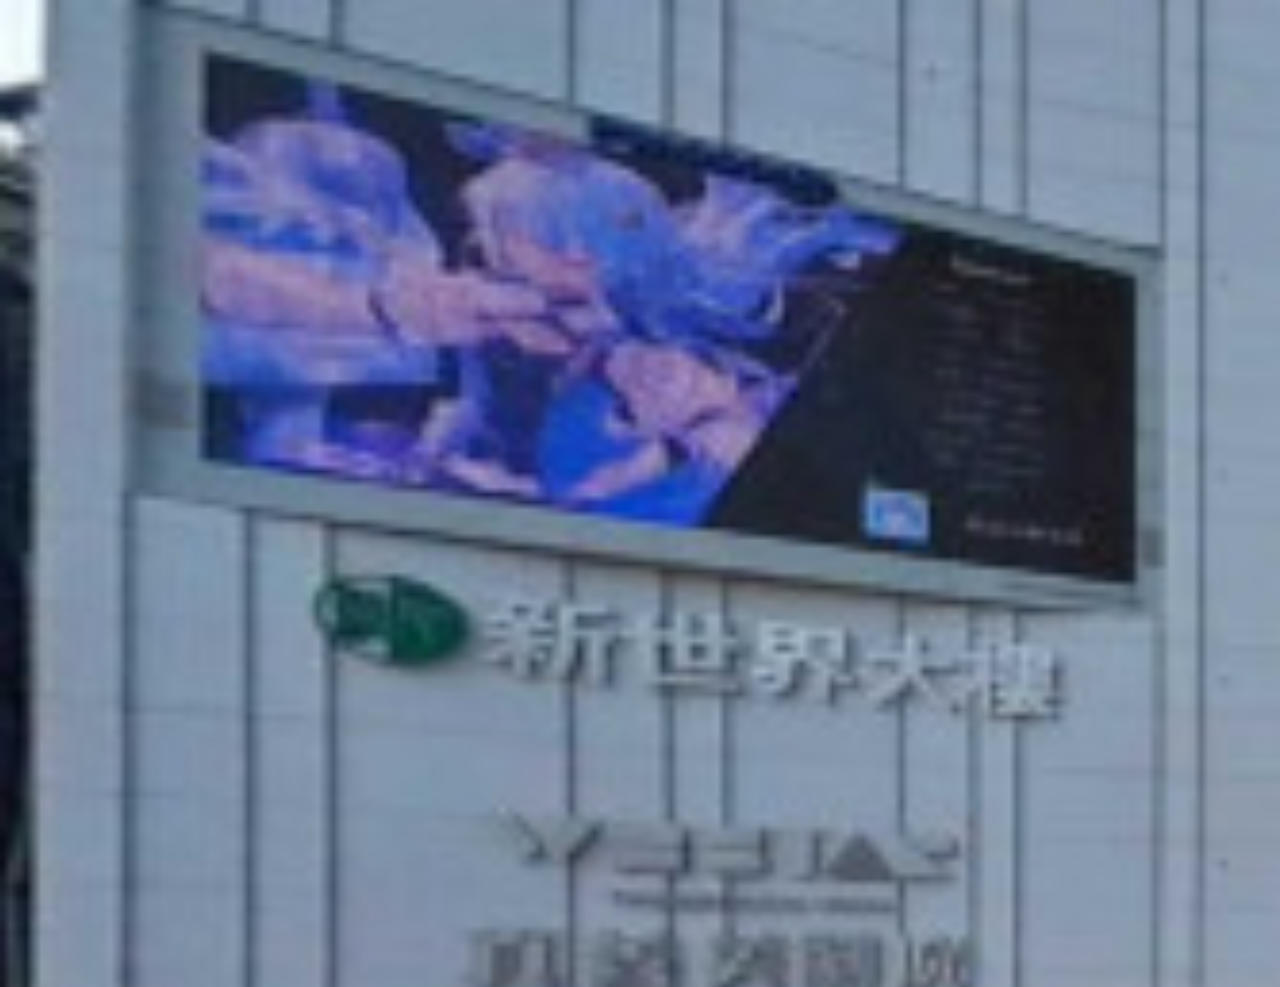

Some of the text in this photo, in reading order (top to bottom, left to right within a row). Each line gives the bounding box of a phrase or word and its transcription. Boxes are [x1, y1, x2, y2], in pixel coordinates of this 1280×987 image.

[484, 600, 1062, 722] 新世界大樓
